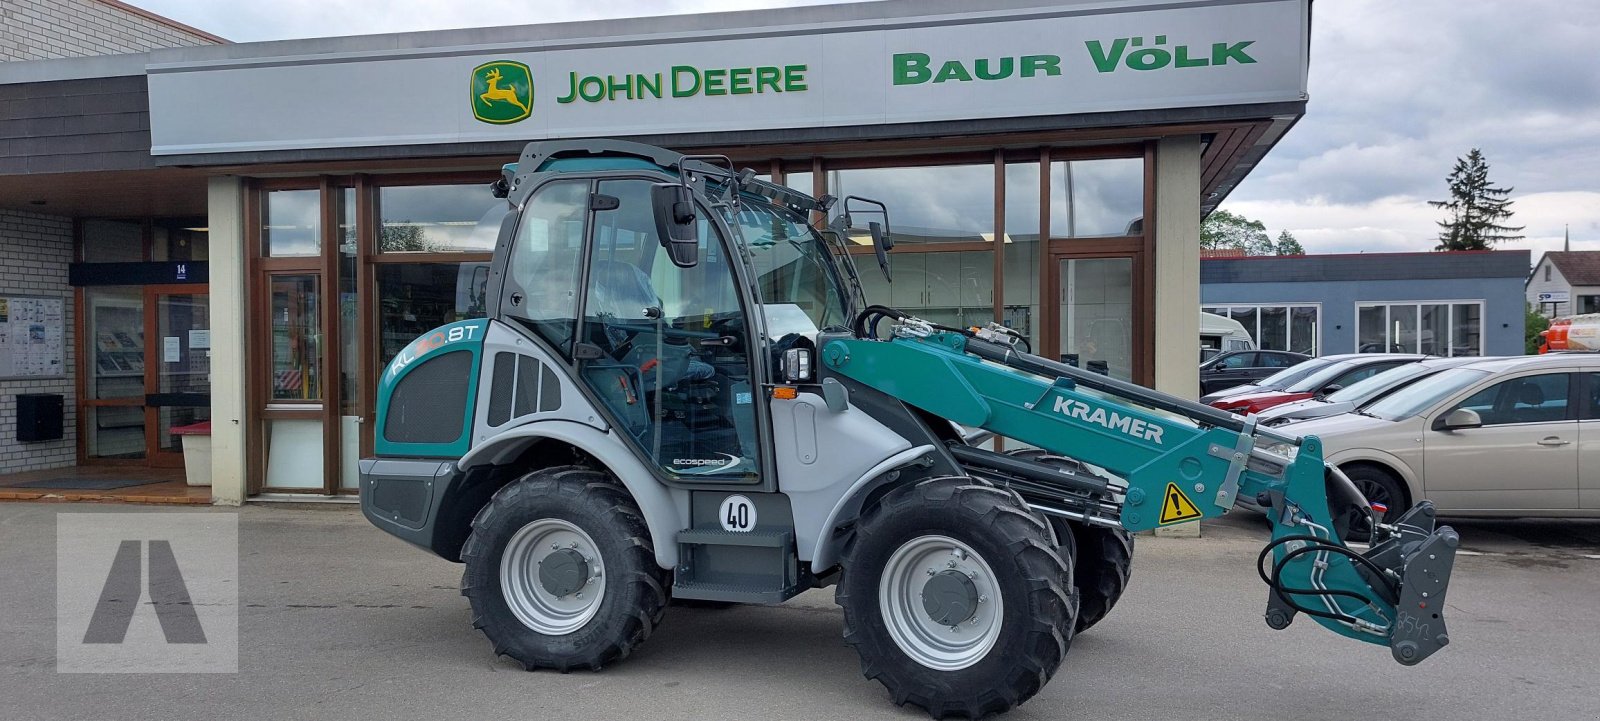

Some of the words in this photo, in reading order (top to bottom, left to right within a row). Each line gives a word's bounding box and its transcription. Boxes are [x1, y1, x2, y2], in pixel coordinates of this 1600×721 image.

[892, 52, 1063, 86] BAUR
[1084, 34, 1258, 73] VÖLK
[556, 70, 663, 104] JOHN
[671, 64, 808, 98] DEERE
[176, 264, 186, 274] 14
[1053, 395, 1164, 445] KRAMER
[673, 458, 725, 467] ecospeed
[727, 502, 748, 529] 40
